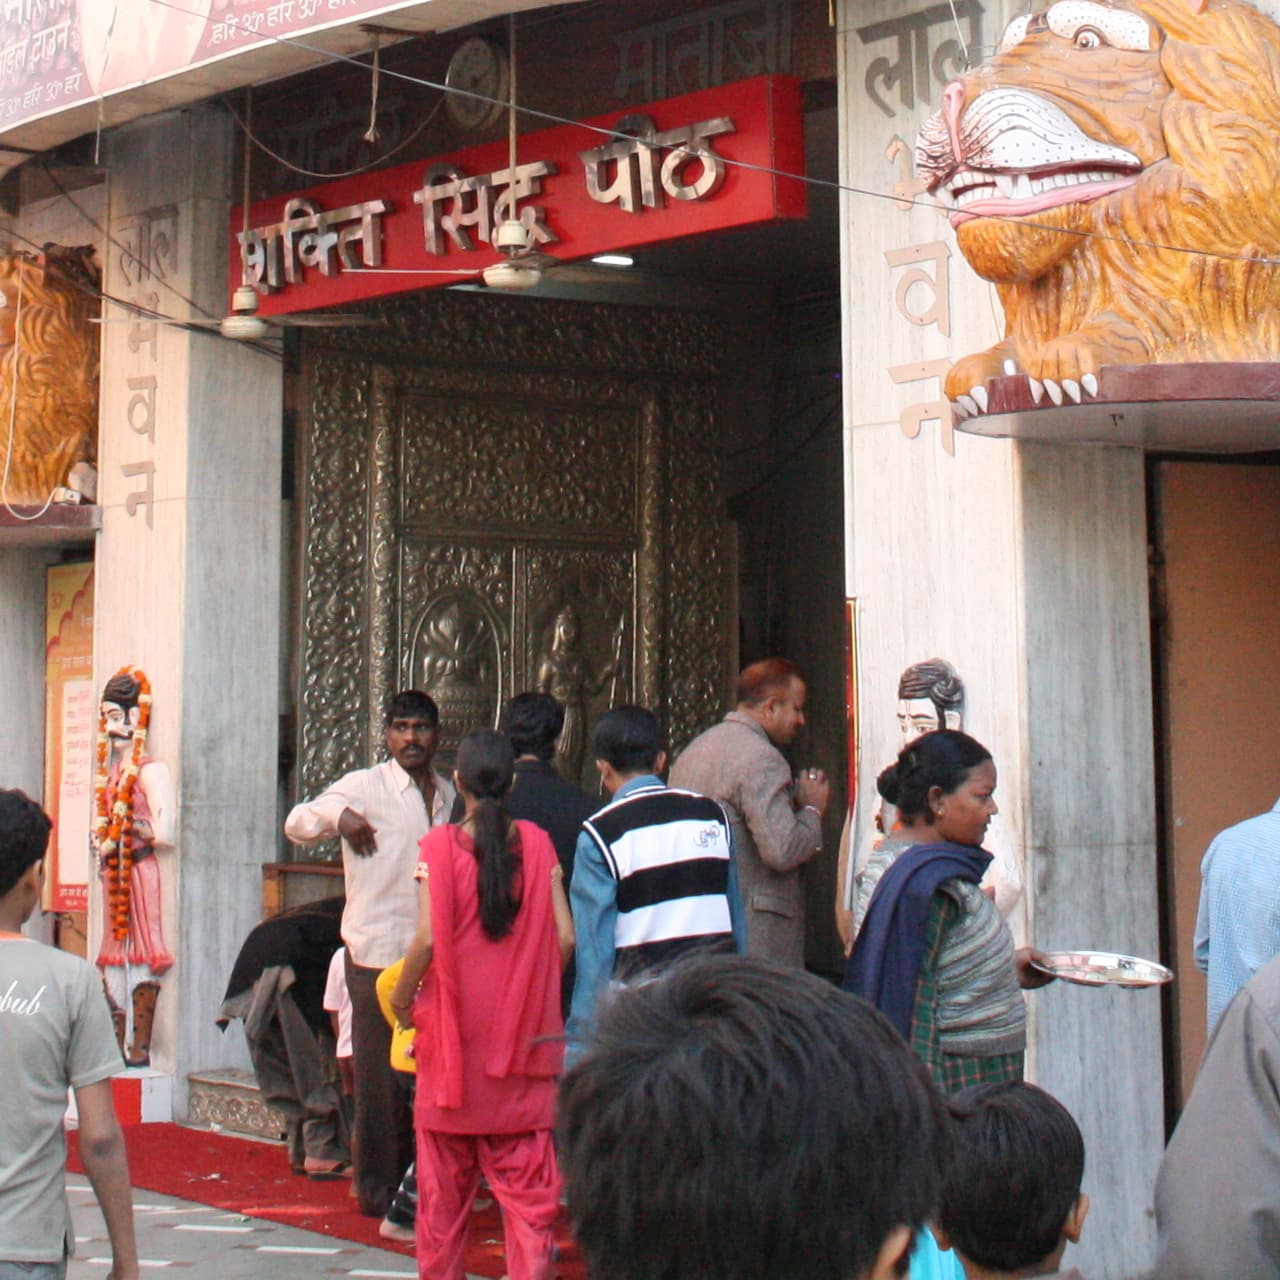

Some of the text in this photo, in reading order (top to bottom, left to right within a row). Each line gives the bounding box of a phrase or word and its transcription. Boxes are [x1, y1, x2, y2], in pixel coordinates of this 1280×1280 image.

[211, 14, 239, 45] हरि
[118, 204, 180, 286] लाल
[235, 199, 392, 296] शक्ति
[579, 115, 736, 214] पीठ
